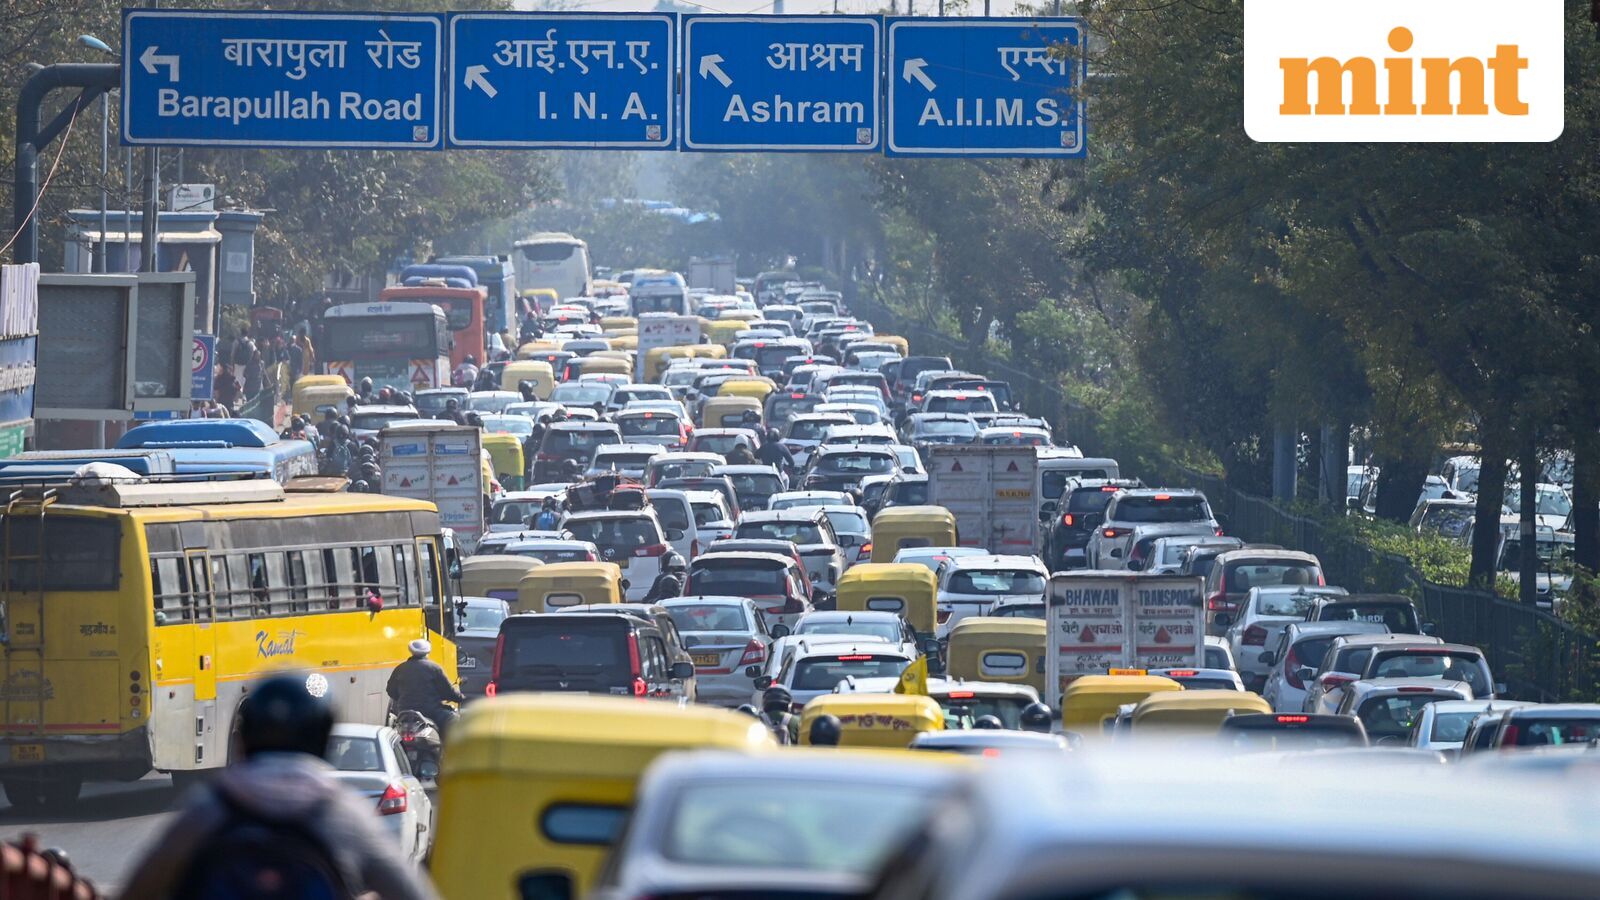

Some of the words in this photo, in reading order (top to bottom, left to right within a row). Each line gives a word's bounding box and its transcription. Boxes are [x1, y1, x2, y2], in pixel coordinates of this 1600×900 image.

[222, 38, 347, 80] बारापुला
[365, 30, 421, 69] रोड
[766, 42, 864, 72] आश्रम
[998, 47, 1066, 82] एम्स
[158, 90, 330, 125] Barapullah
[340, 93, 421, 120] Road
[723, 95, 864, 122] Ashram
[918, 98, 1069, 126] A.I.I.M.S.
[1066, 589, 1119, 606] BHAWAN
[1138, 589, 1196, 606] TRANSPORT
